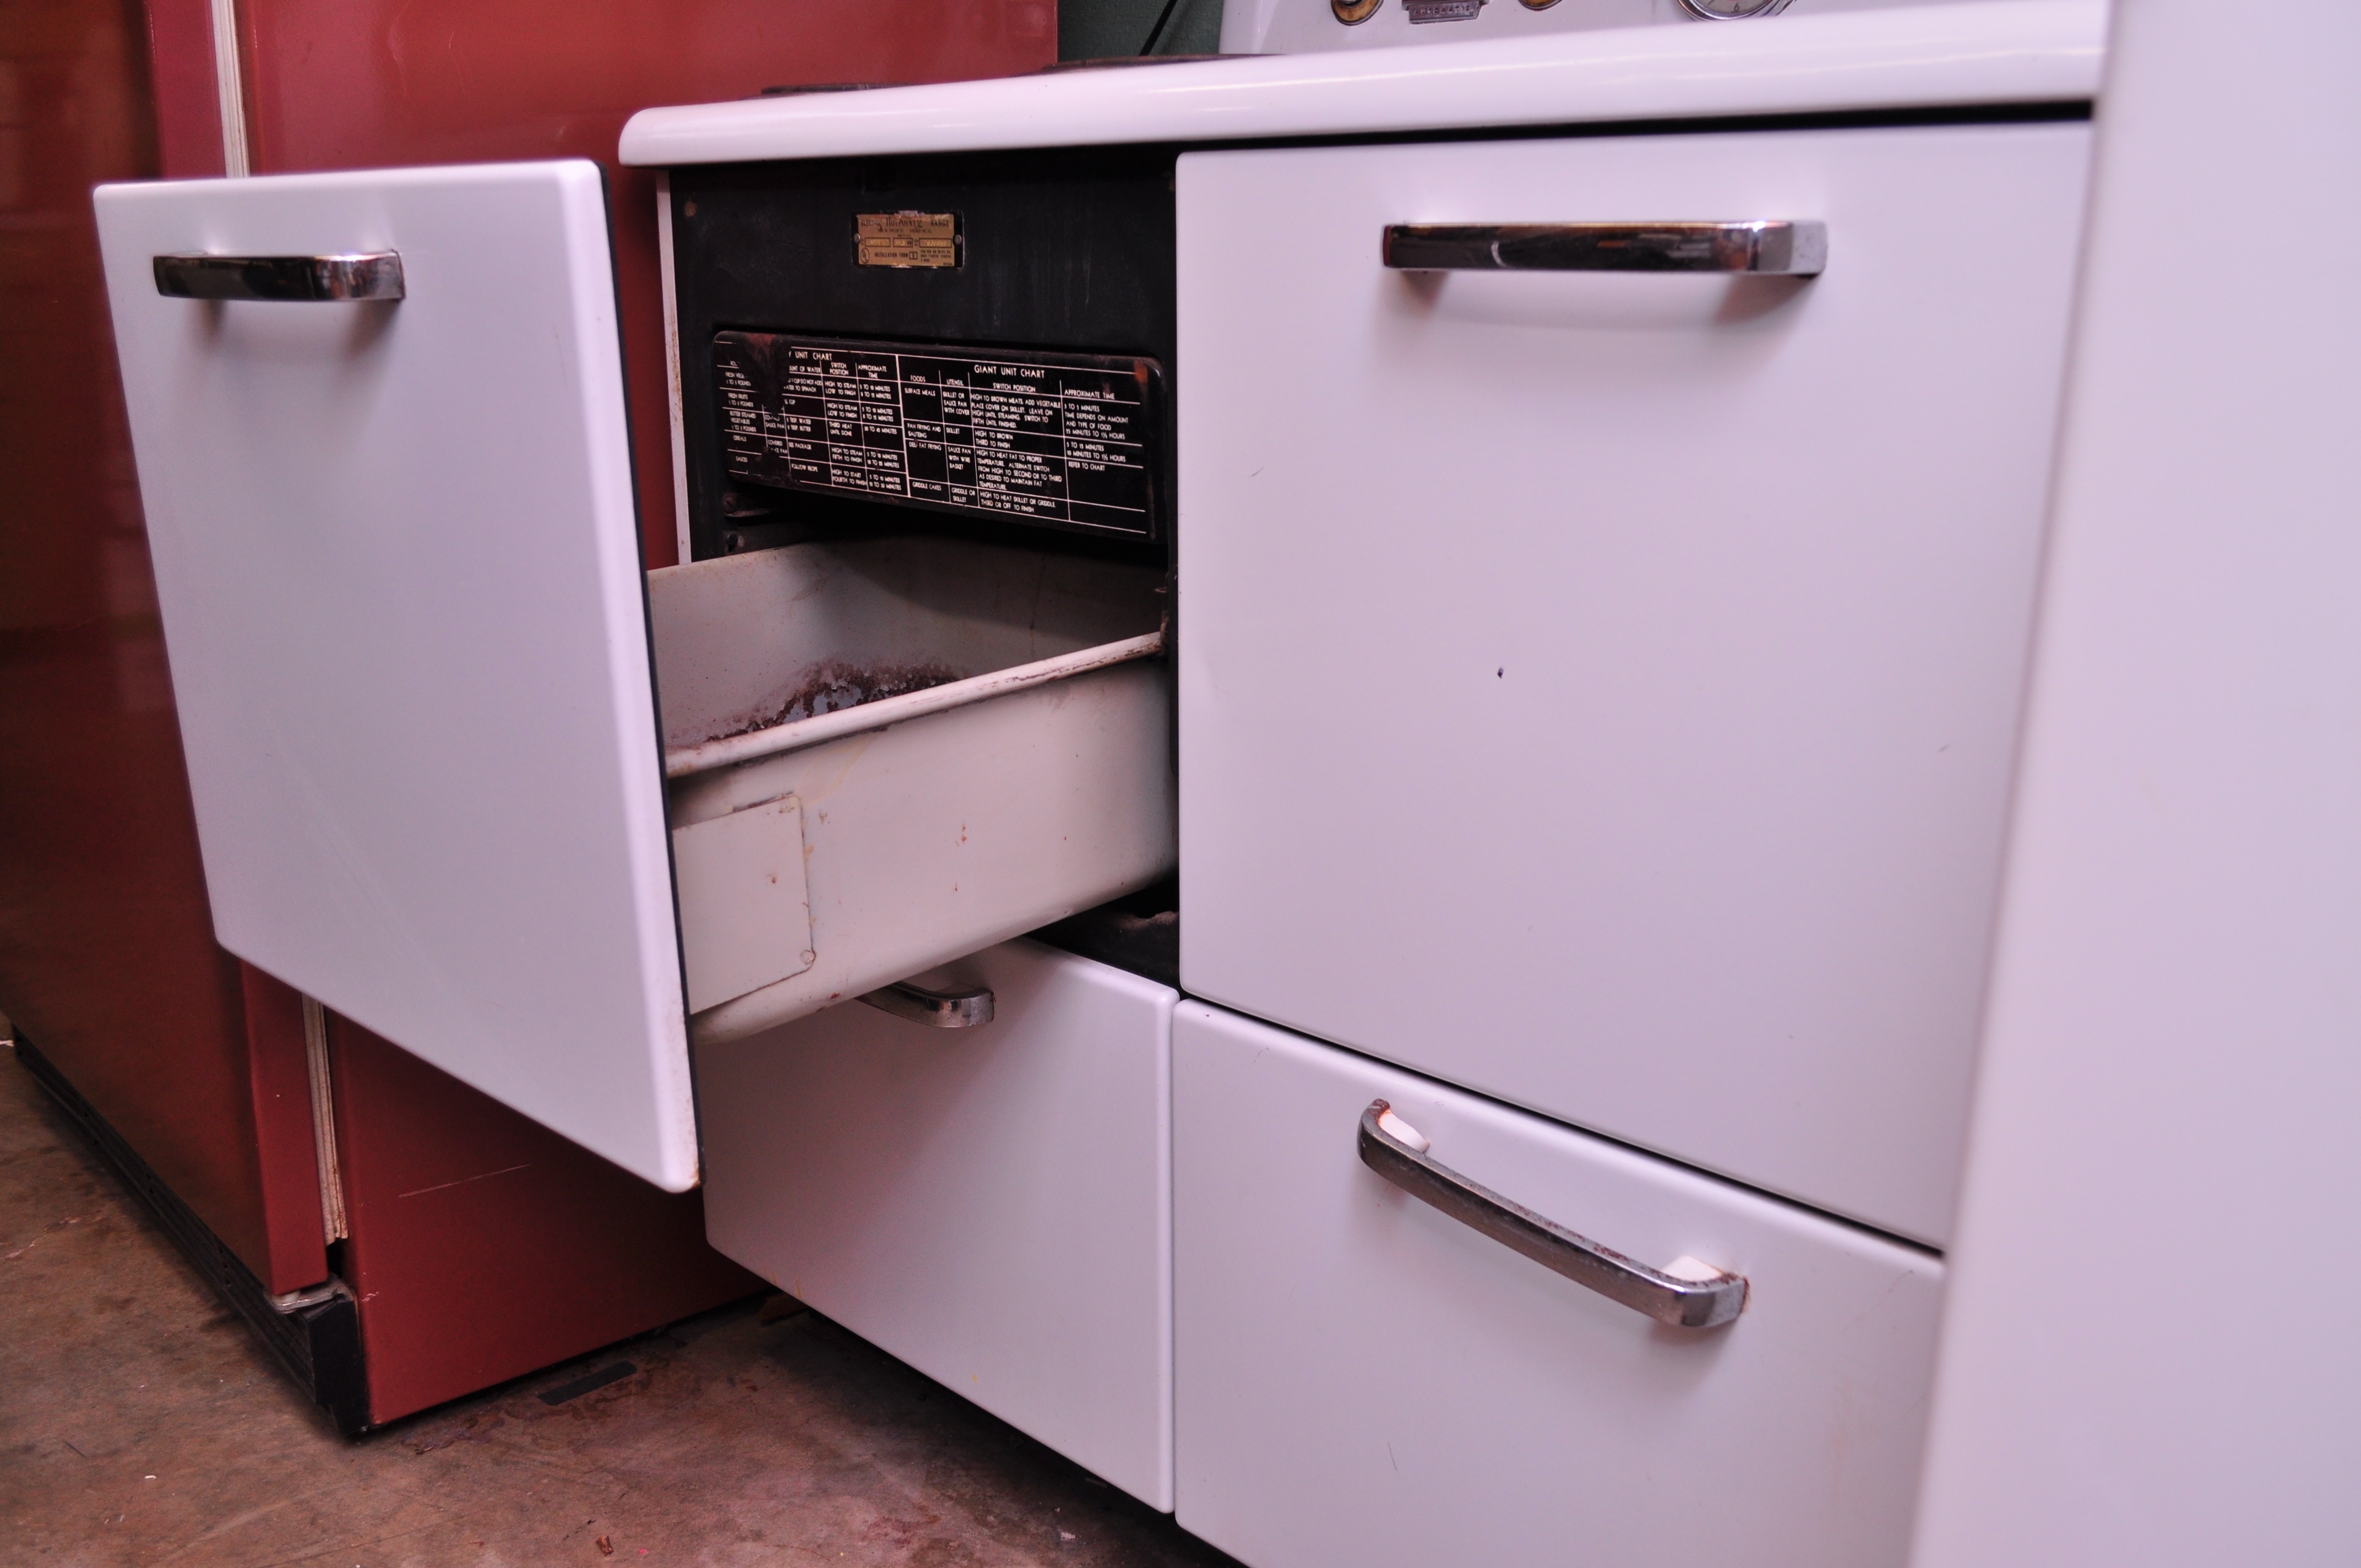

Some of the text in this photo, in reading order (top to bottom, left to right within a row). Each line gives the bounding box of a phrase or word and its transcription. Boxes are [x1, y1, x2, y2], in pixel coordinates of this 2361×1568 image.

[974, 364, 1045, 378] GIANT UNIT CHART
[1064, 389, 1100, 398] APPROXIMATE
[1036, 400, 1060, 408] VEGETABLE
